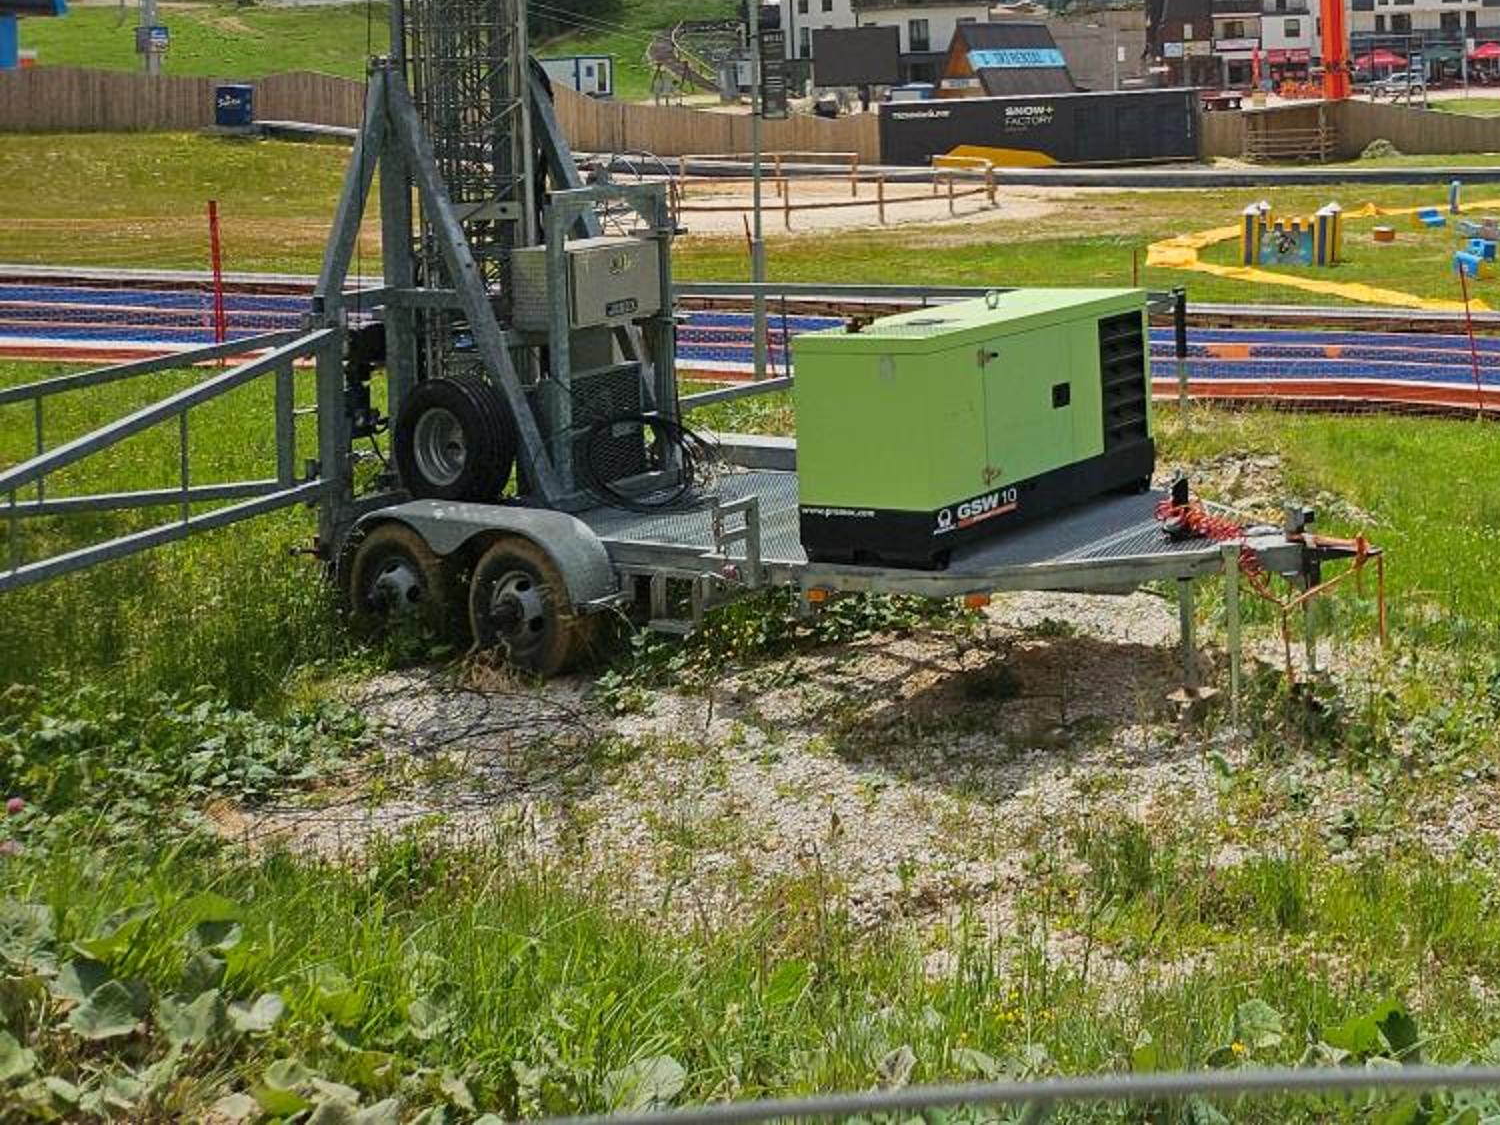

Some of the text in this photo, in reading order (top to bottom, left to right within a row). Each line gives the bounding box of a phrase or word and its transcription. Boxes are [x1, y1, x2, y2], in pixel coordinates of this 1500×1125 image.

[1005, 116, 1053, 126] FACTORY
[957, 493, 998, 518] GSW
[1002, 488, 1017, 503] 10
